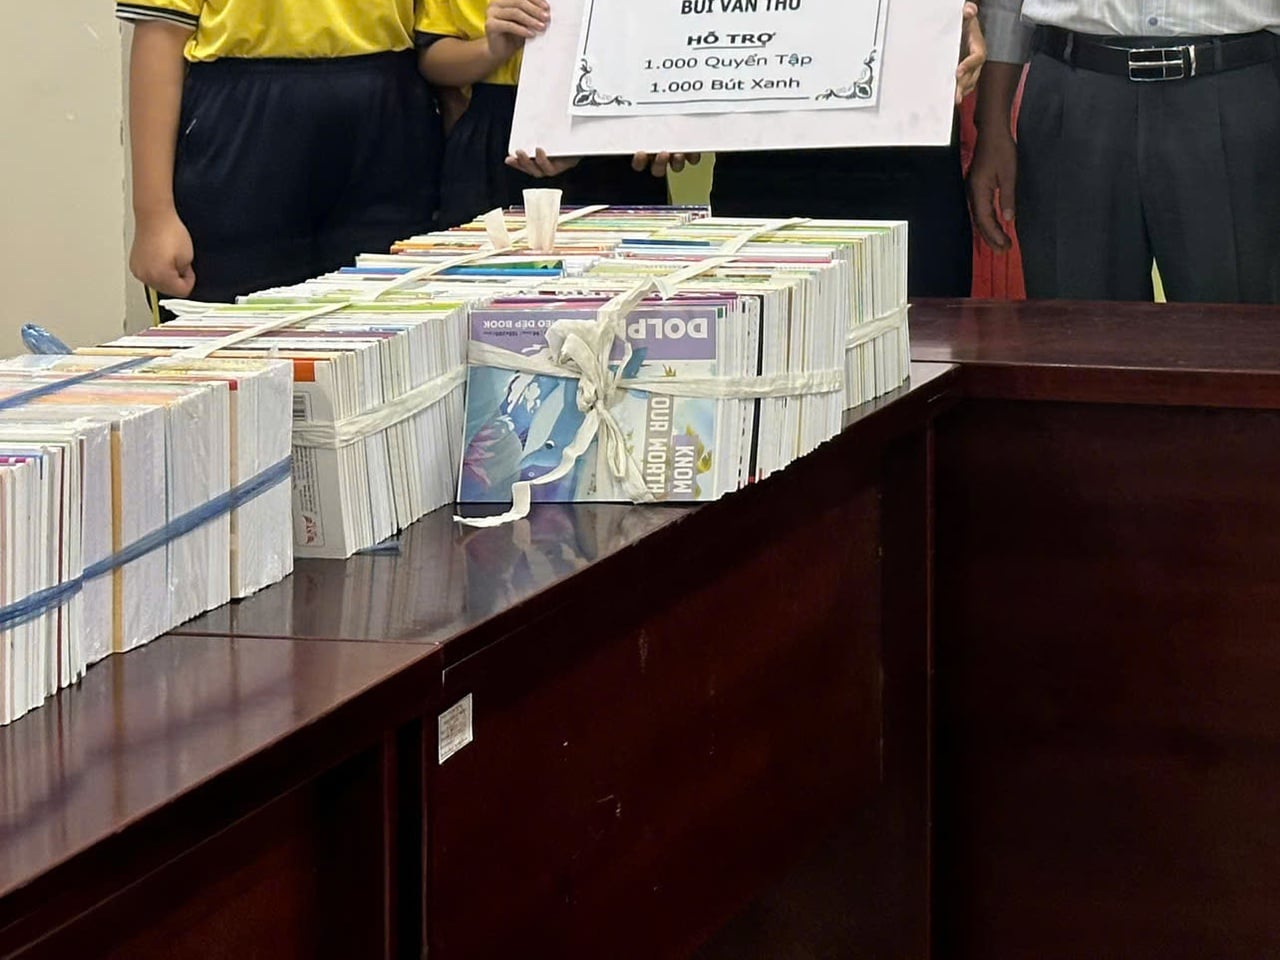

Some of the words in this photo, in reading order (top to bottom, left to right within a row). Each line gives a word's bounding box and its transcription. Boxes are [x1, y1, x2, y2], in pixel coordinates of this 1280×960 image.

[726, 32, 777, 48] TRỢ
[644, 57, 698, 71] 1.000
[775, 53, 813, 68] Tập
[650, 79, 704, 94] 1.000
[710, 78, 745, 91] Bút
[750, 77, 801, 90] Xanh
[483, 320, 513, 329] BOOK
[646, 440, 668, 494] WORTH
[673, 445, 695, 494] KNOW
